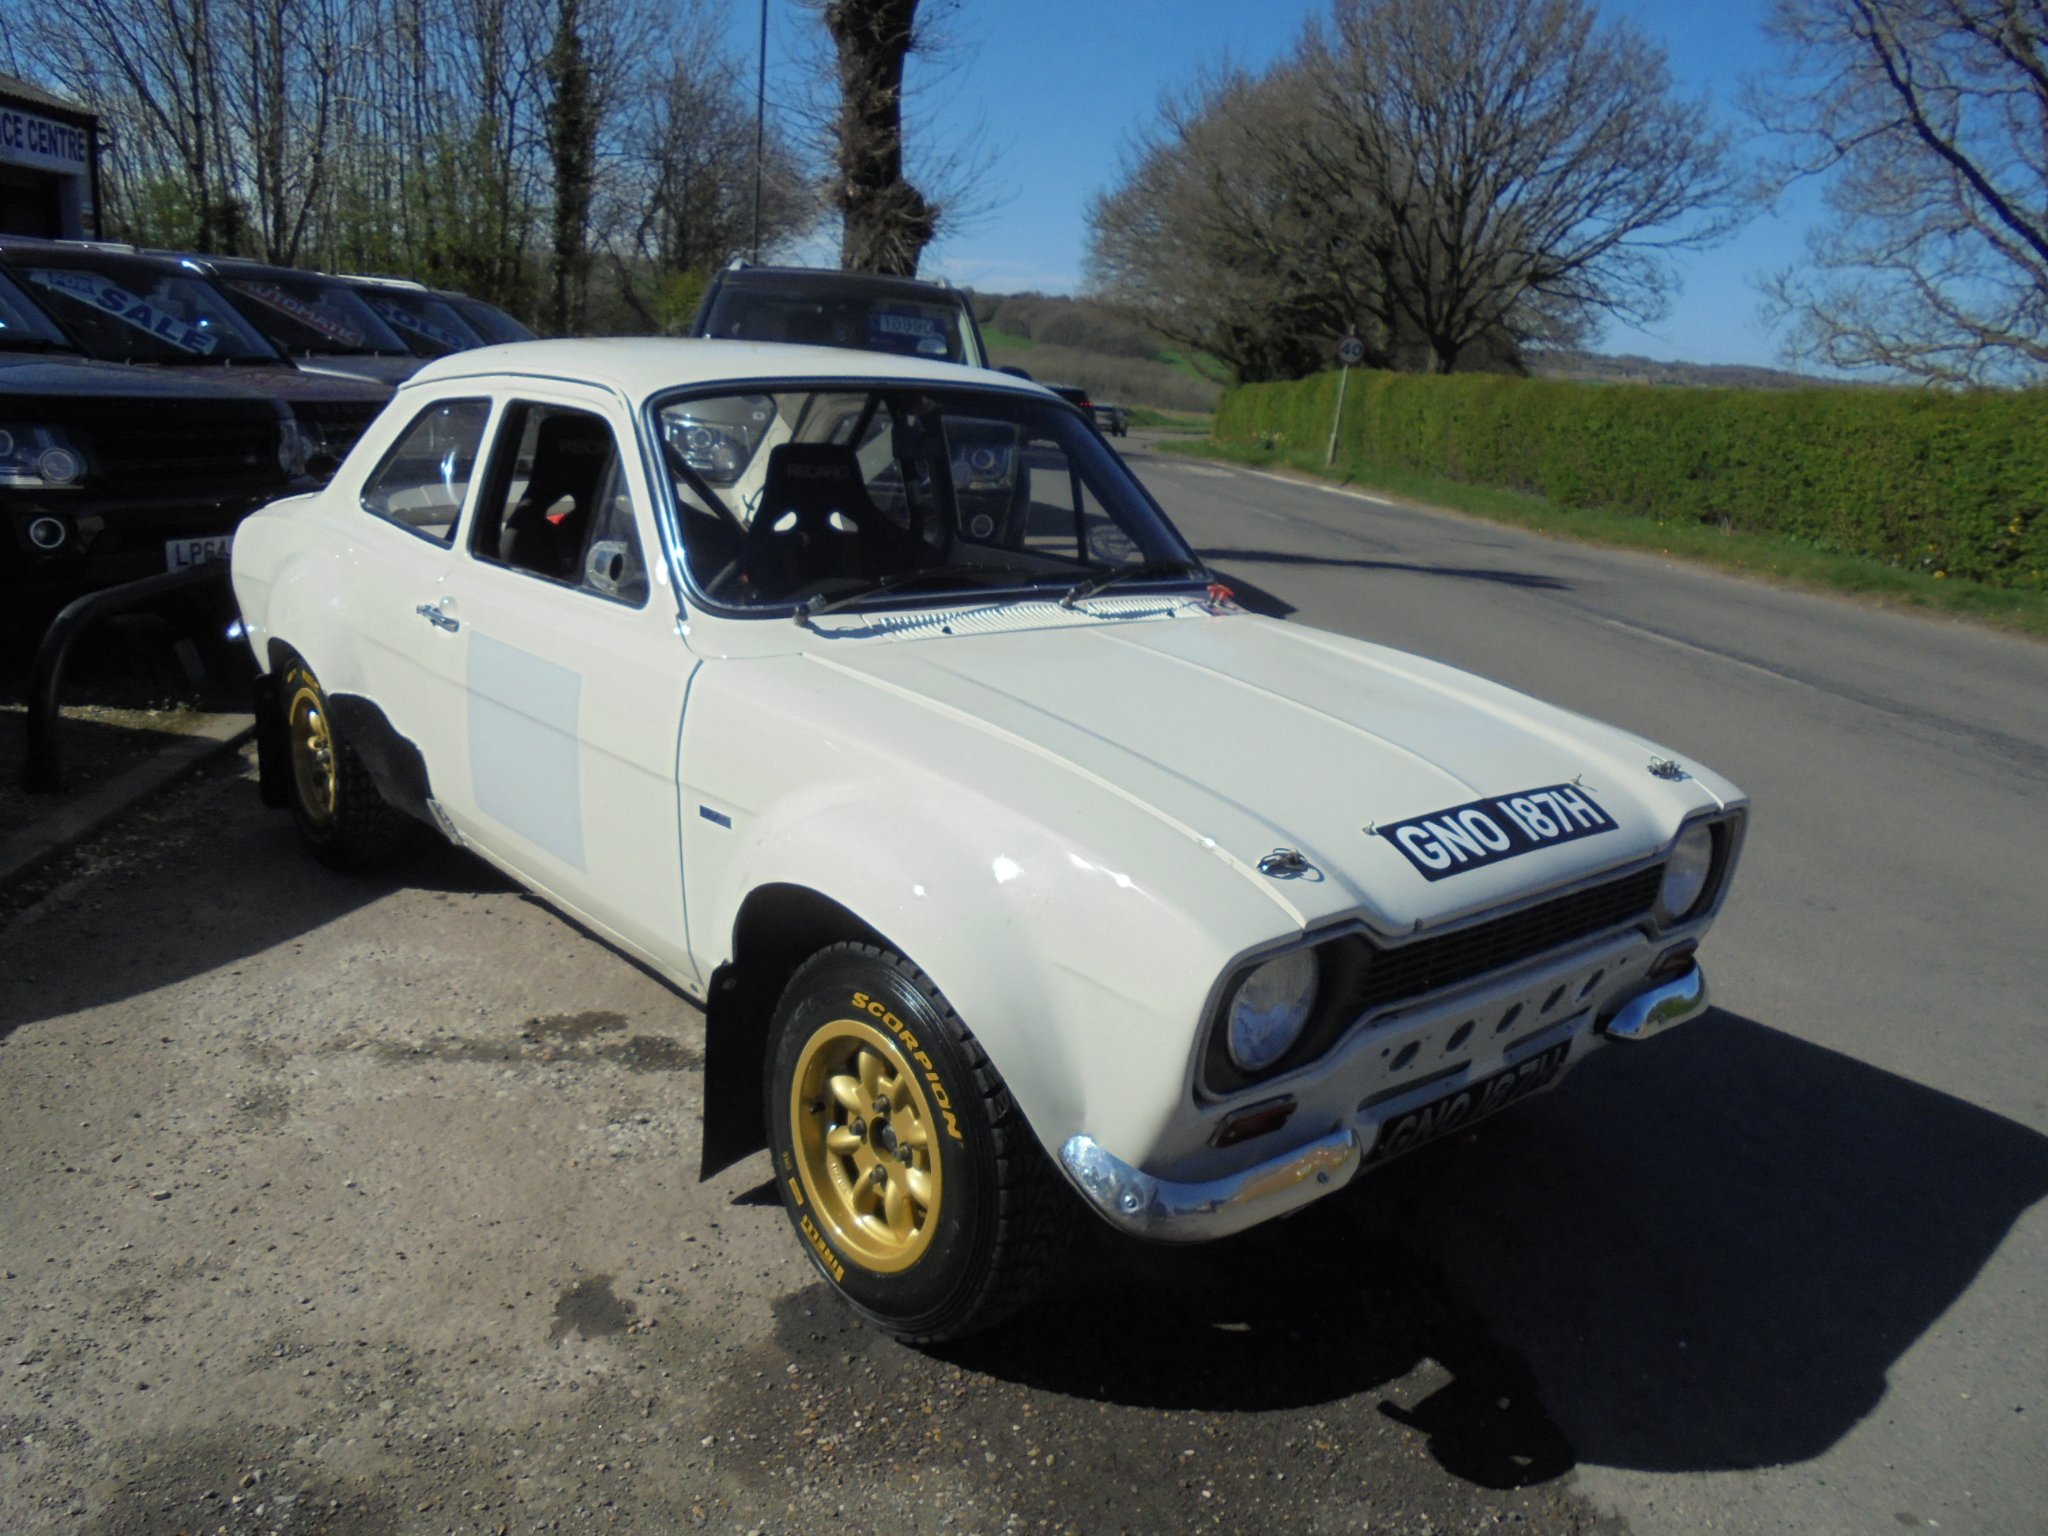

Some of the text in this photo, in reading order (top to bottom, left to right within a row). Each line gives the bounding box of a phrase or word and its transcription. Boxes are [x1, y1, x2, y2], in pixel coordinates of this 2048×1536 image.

[27, 119, 86, 162] CENTRE
[97, 287, 212, 351] SALE
[1397, 788, 1605, 870] GNO 187H
[852, 992, 962, 1139] SCORPION
